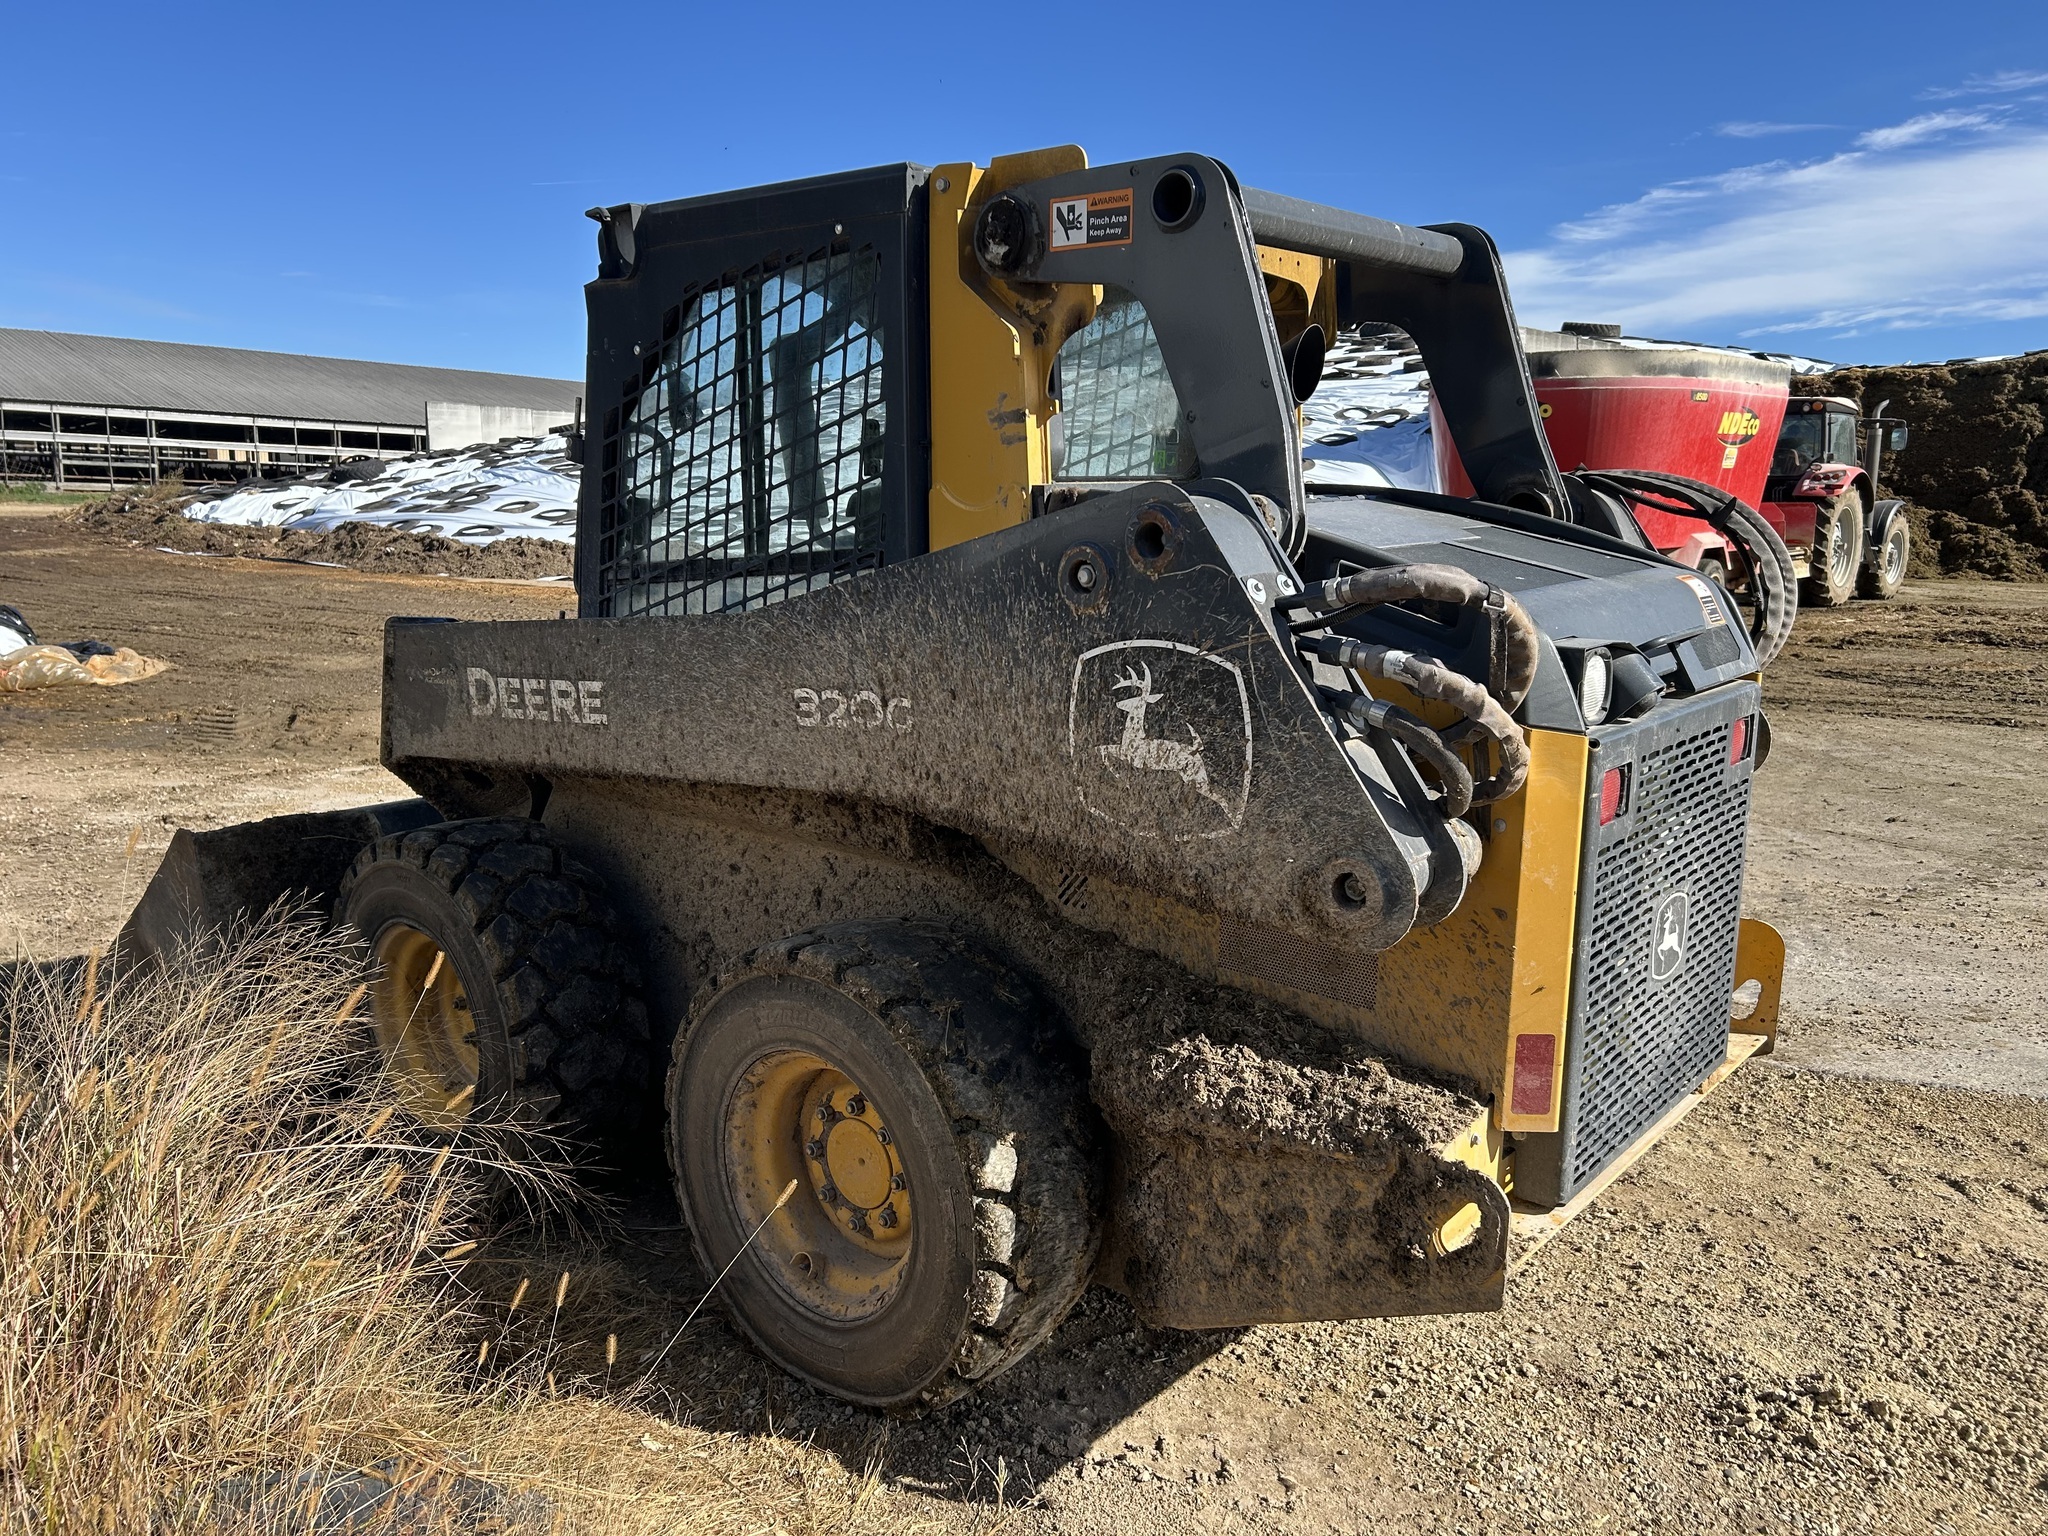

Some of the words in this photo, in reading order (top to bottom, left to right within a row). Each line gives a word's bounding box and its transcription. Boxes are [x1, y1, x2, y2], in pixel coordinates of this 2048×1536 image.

[1097, 194, 1129, 205] WARNING
[1089, 216, 1109, 226] Pinch
[1110, 214, 1128, 223] Area
[1089, 229, 1105, 237] Keep
[1105, 227, 1122, 235] Away
[1717, 411, 1760, 436] NDEco
[467, 667, 608, 725] DEERE
